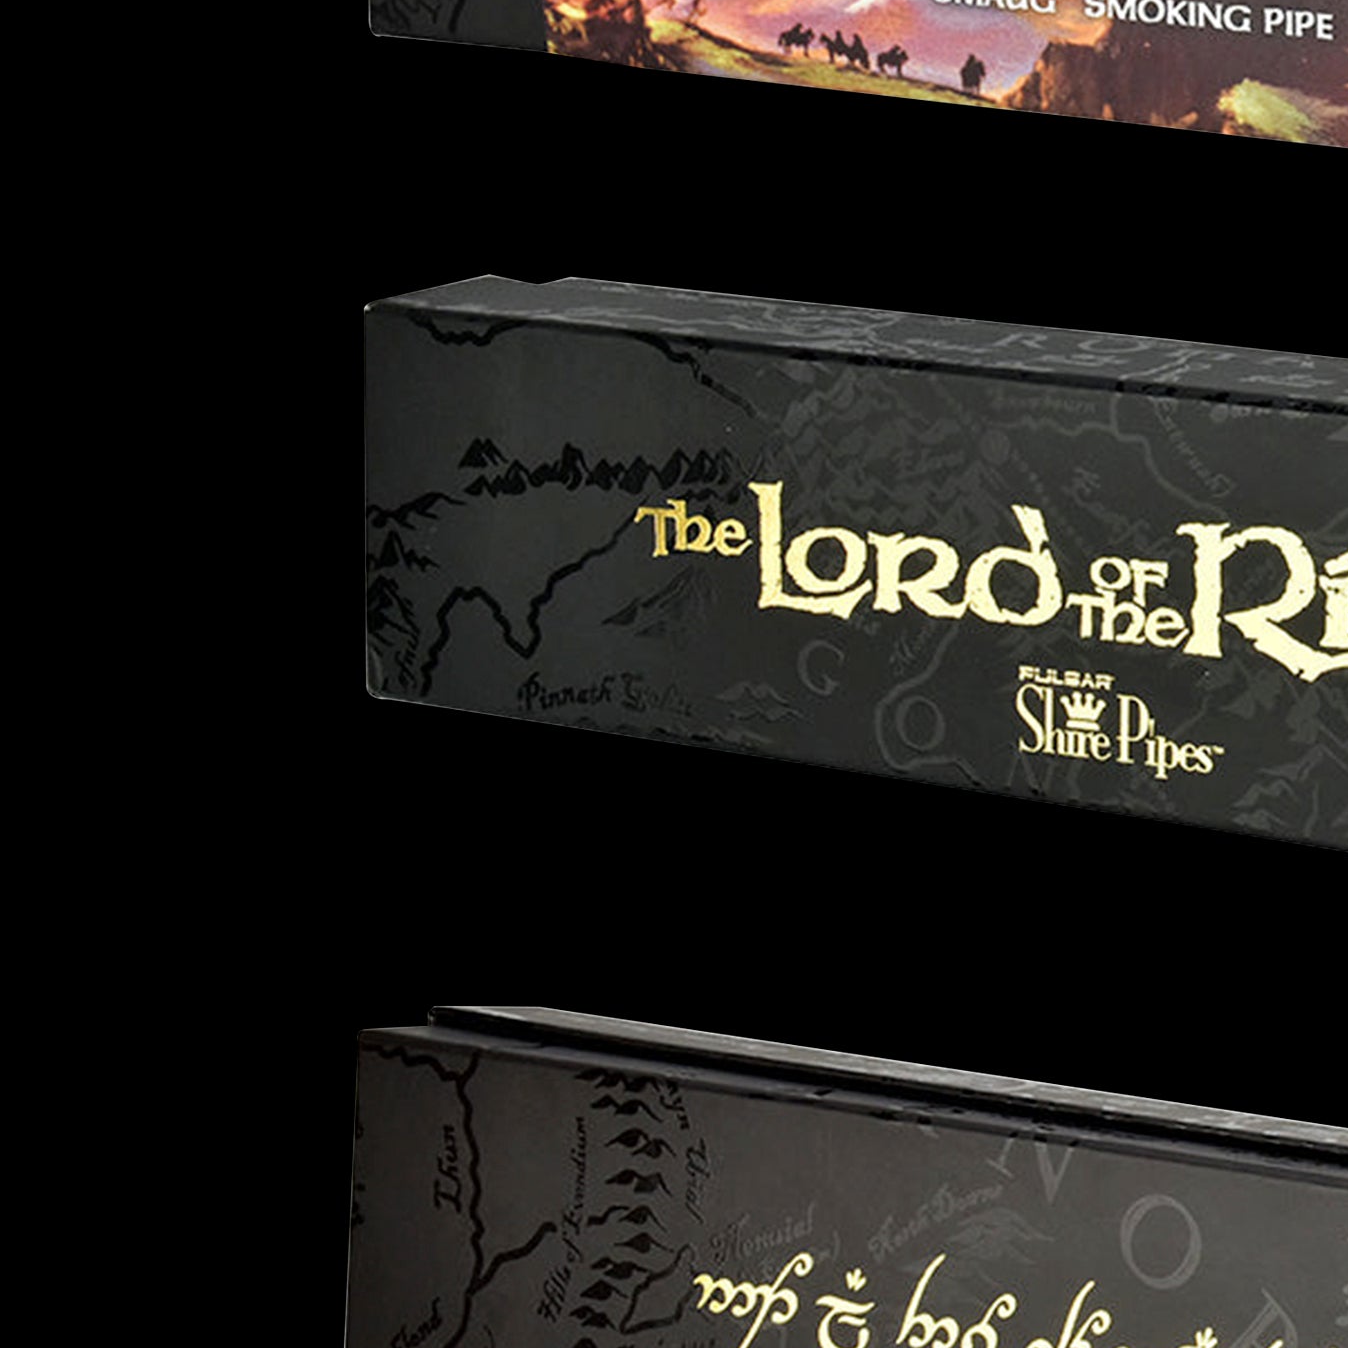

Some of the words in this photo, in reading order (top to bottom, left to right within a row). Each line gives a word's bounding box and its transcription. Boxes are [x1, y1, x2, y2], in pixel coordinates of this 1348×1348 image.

[1263, 6, 1334, 40] PIPE
[633, 497, 755, 559] The
[747, 479, 1066, 629] Lord
[1065, 590, 1191, 648] The
